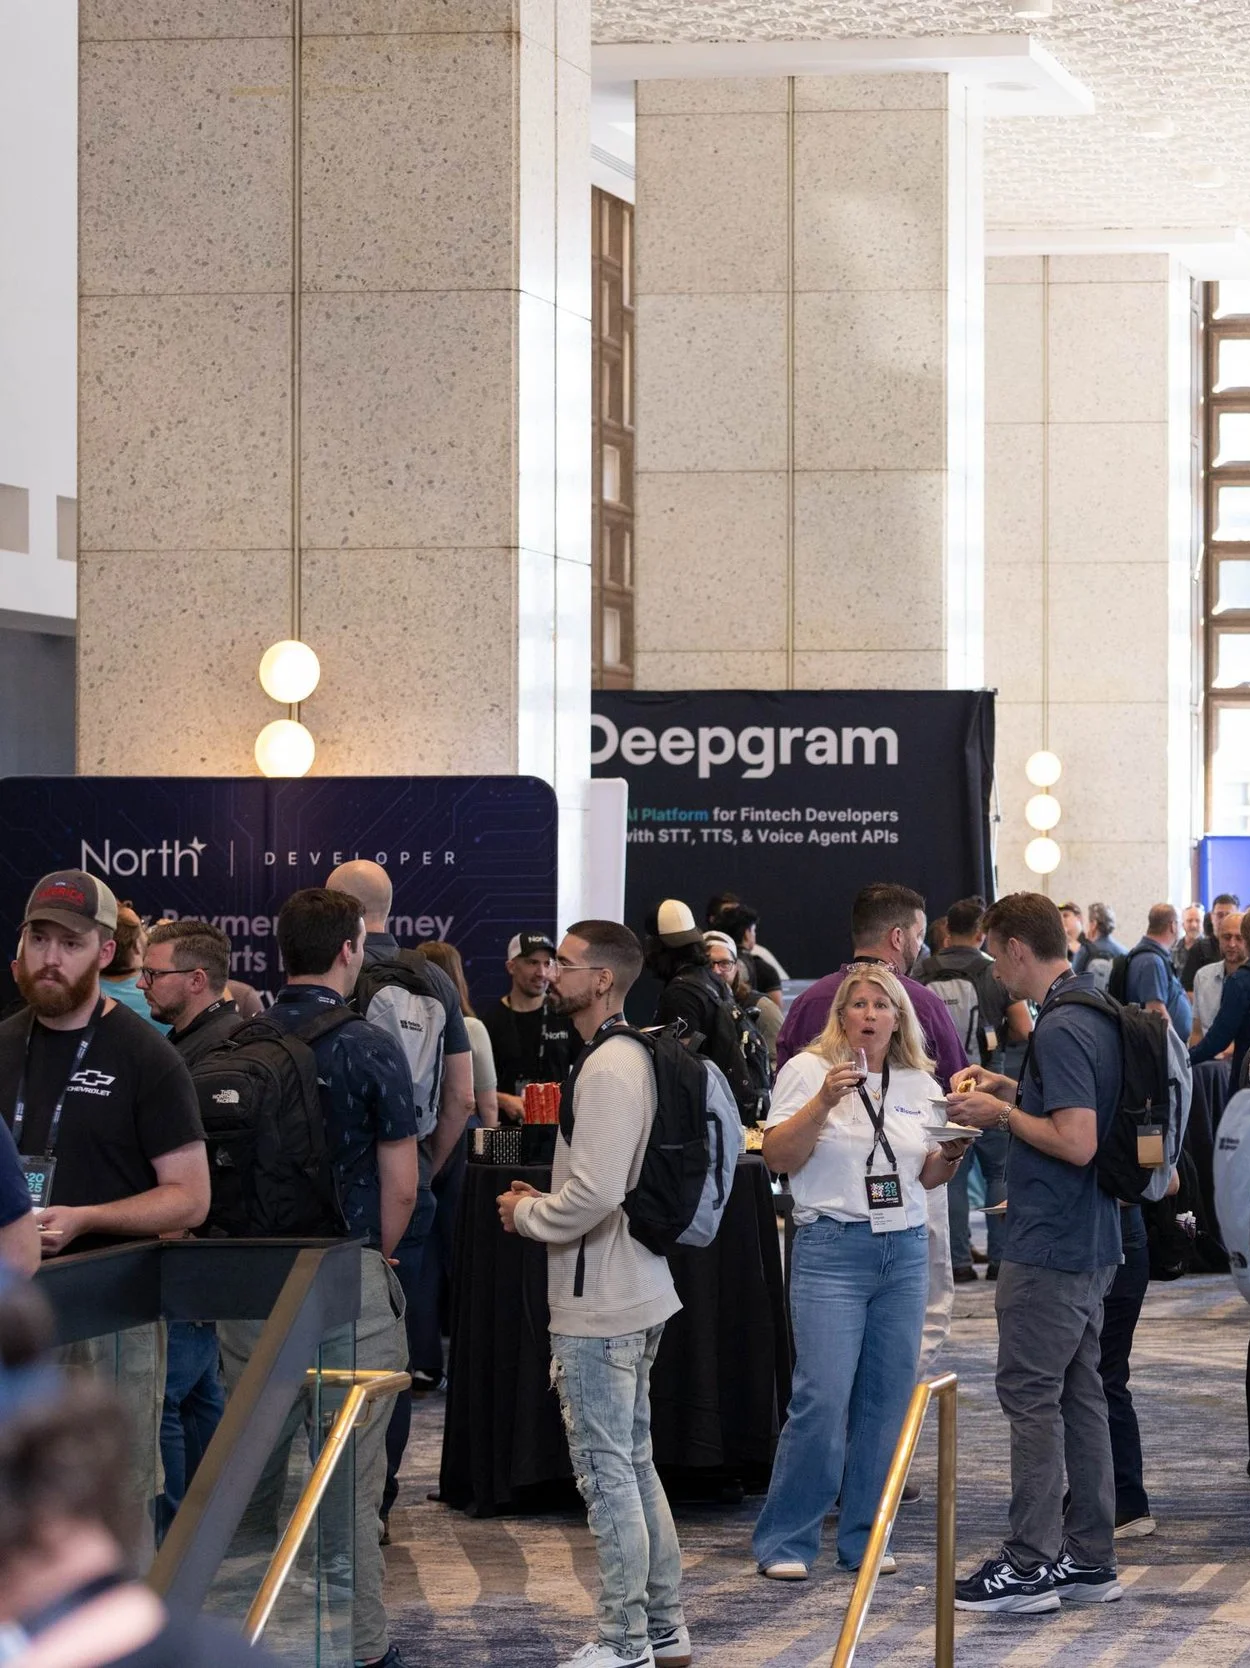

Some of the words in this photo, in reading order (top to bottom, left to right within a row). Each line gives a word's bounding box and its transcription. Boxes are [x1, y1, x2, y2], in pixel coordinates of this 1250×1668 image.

[591, 714, 899, 779] Deepgram
[642, 807, 709, 822] Platform
[713, 807, 737, 821] for
[740, 807, 801, 821] Fintech
[805, 807, 899, 825] Developers
[658, 829, 696, 845] STT,
[701, 829, 737, 845] TTS,
[741, 829, 753, 843] &
[757, 829, 804, 843] Voice
[808, 829, 857, 847] Agent
[861, 829, 899, 843] APIs
[80, 838, 201, 877] North
[66, 1085, 112, 1097] CHEVROLET
